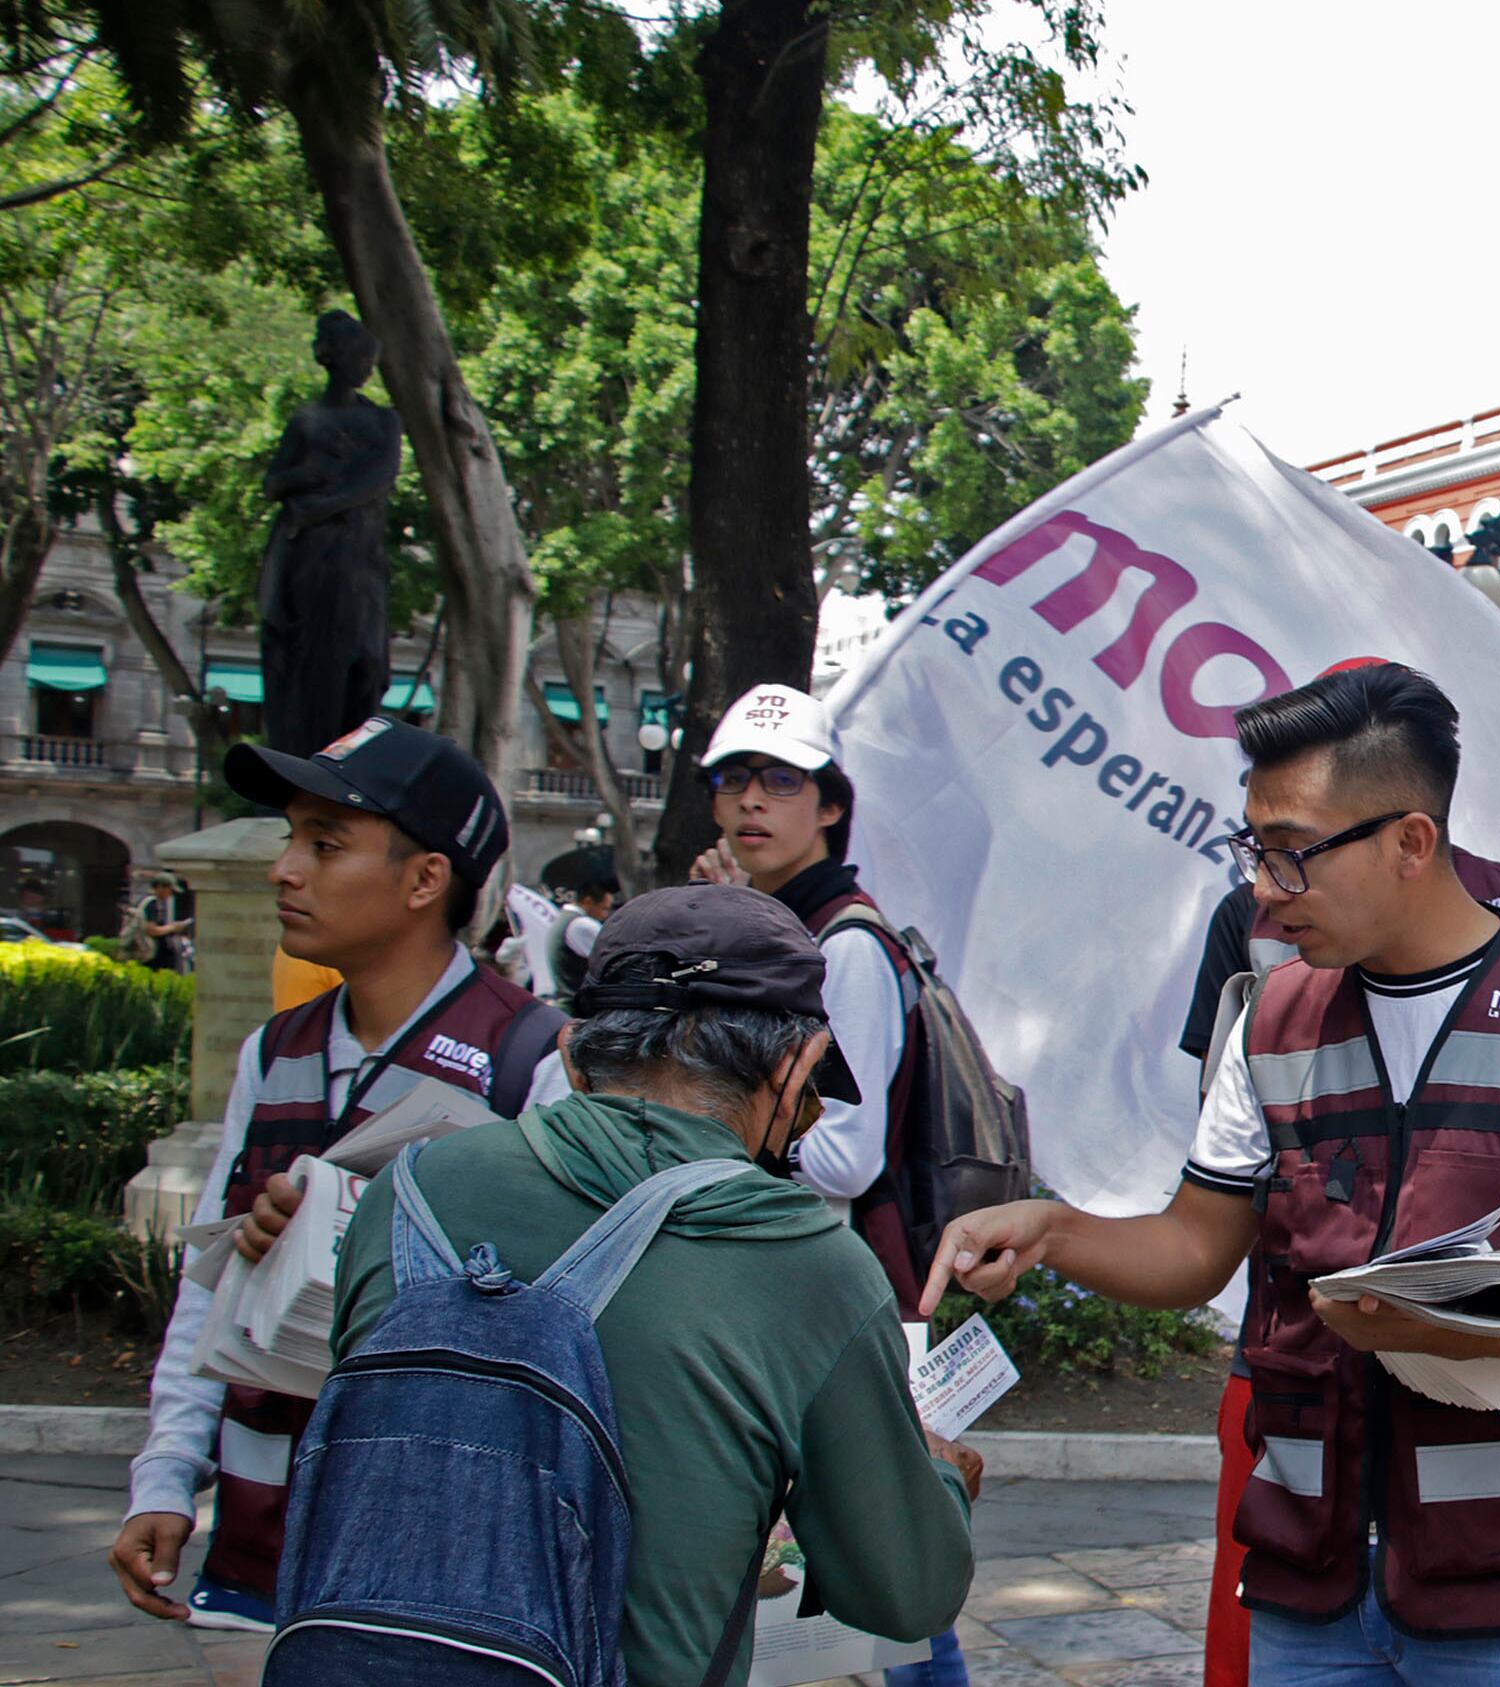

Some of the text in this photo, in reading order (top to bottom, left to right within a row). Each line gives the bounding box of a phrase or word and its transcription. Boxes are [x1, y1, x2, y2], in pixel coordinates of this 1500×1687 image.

[756, 695, 787, 708] YO
[744, 708, 791, 721] SOY
[1487, 1007, 1500, 1018] La
[917, 1325, 983, 1378] DIRIGIDA
[955, 1371, 1006, 1418] morena
